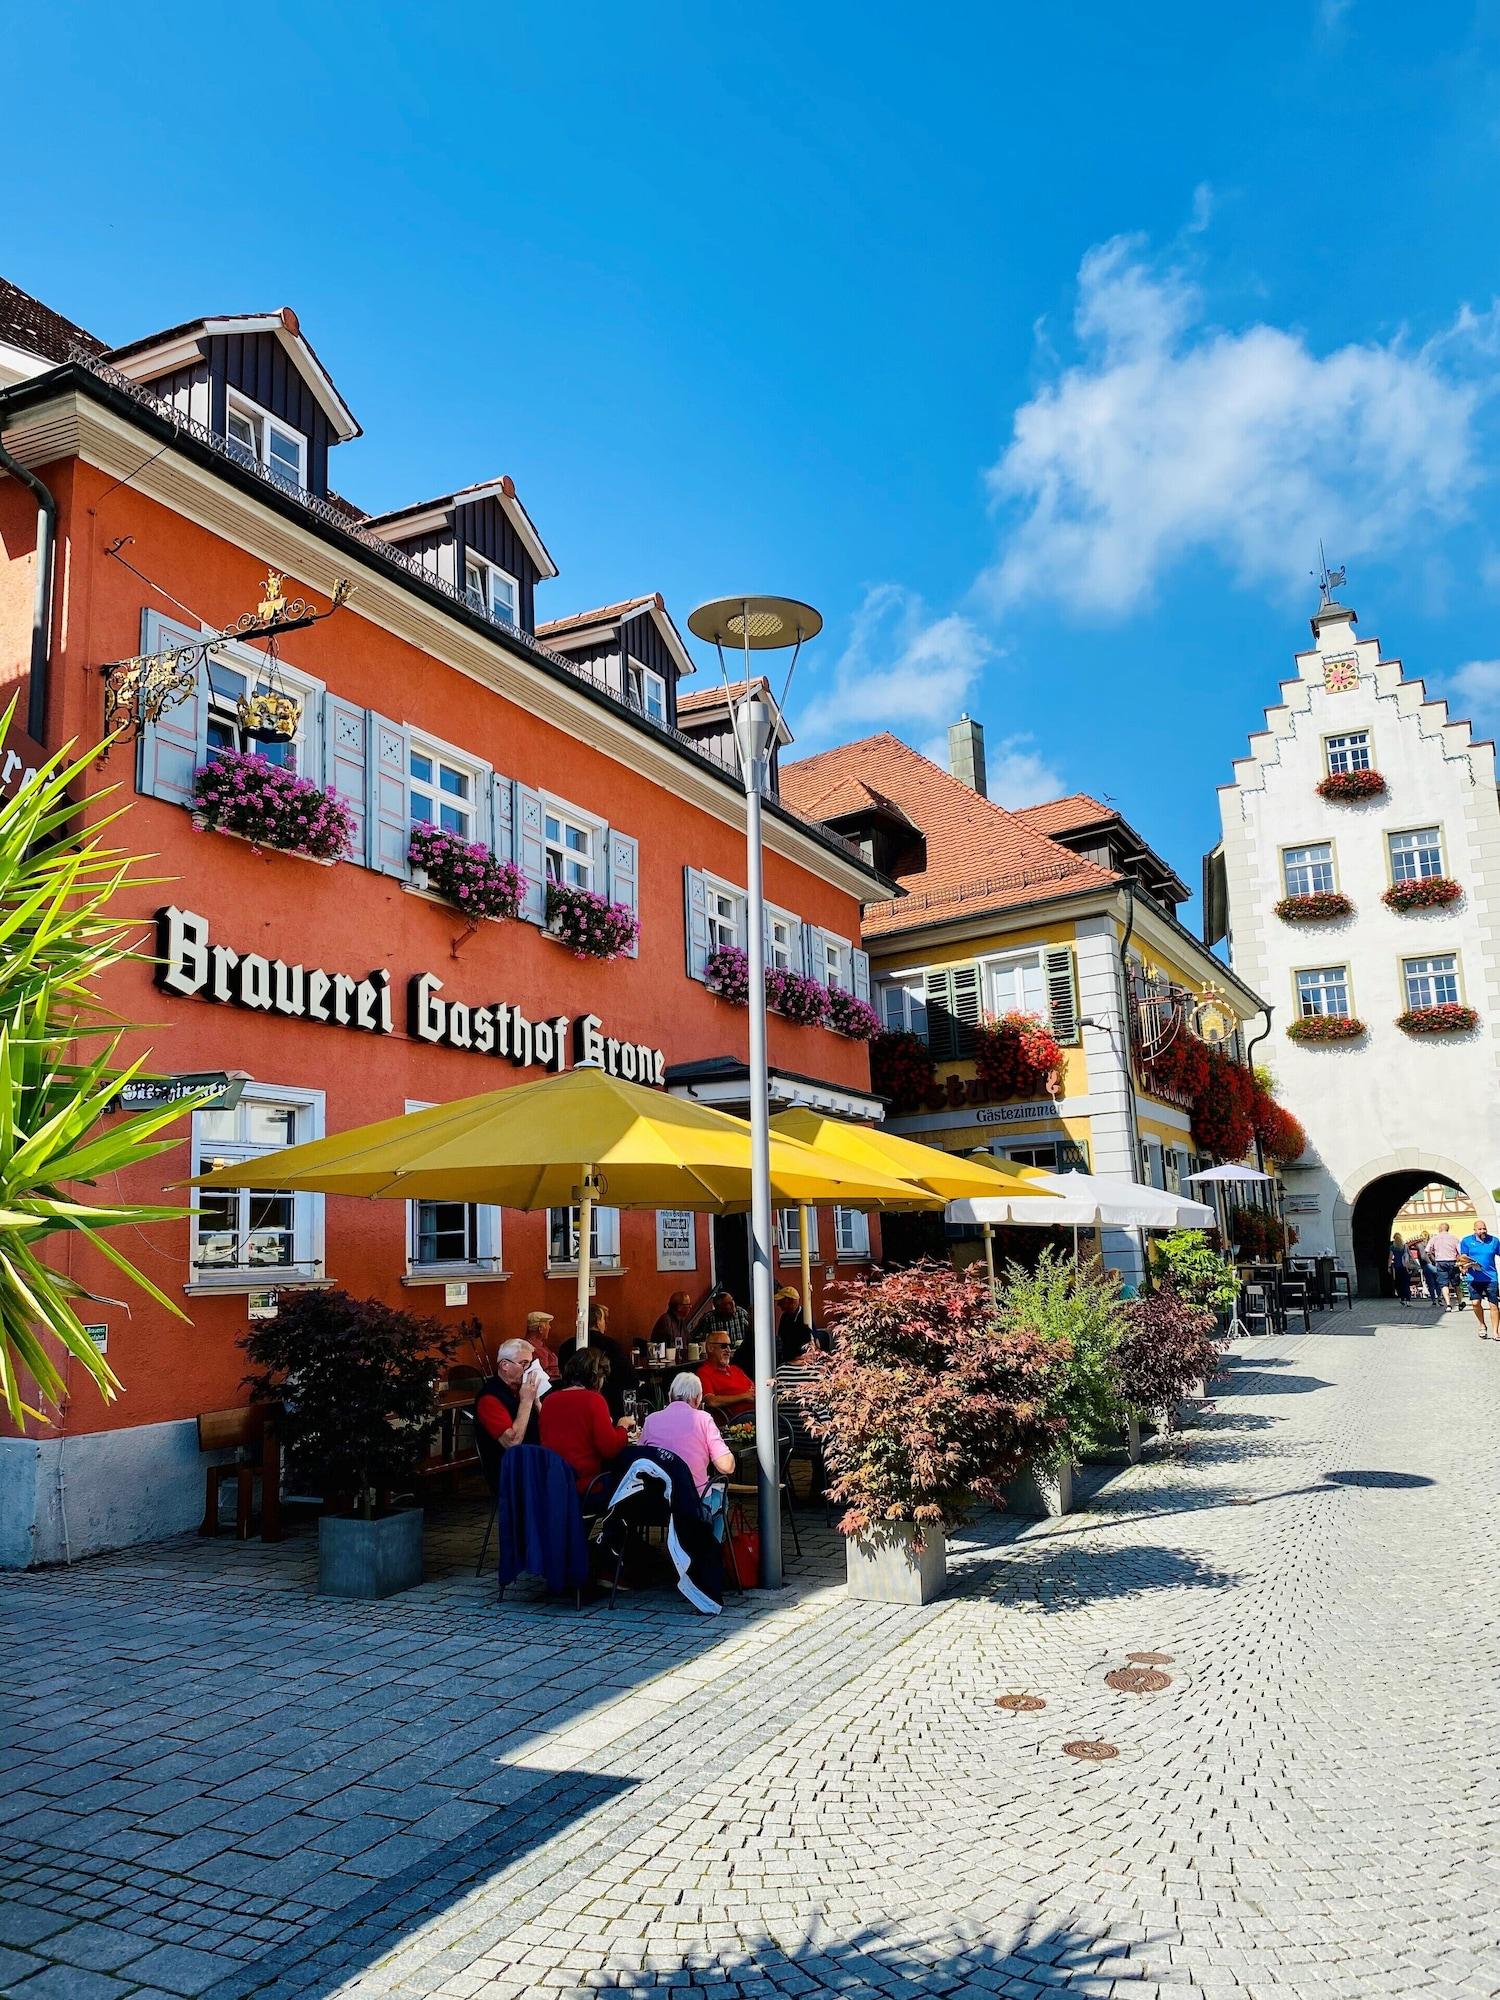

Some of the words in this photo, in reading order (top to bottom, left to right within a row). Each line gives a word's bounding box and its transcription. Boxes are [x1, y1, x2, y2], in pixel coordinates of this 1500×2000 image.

[164, 905, 395, 1034] Brauerei
[417, 971, 571, 1073] Gasthof
[583, 1013, 667, 1087] Krone
[976, 1101, 1065, 1123] Gästezimmer
